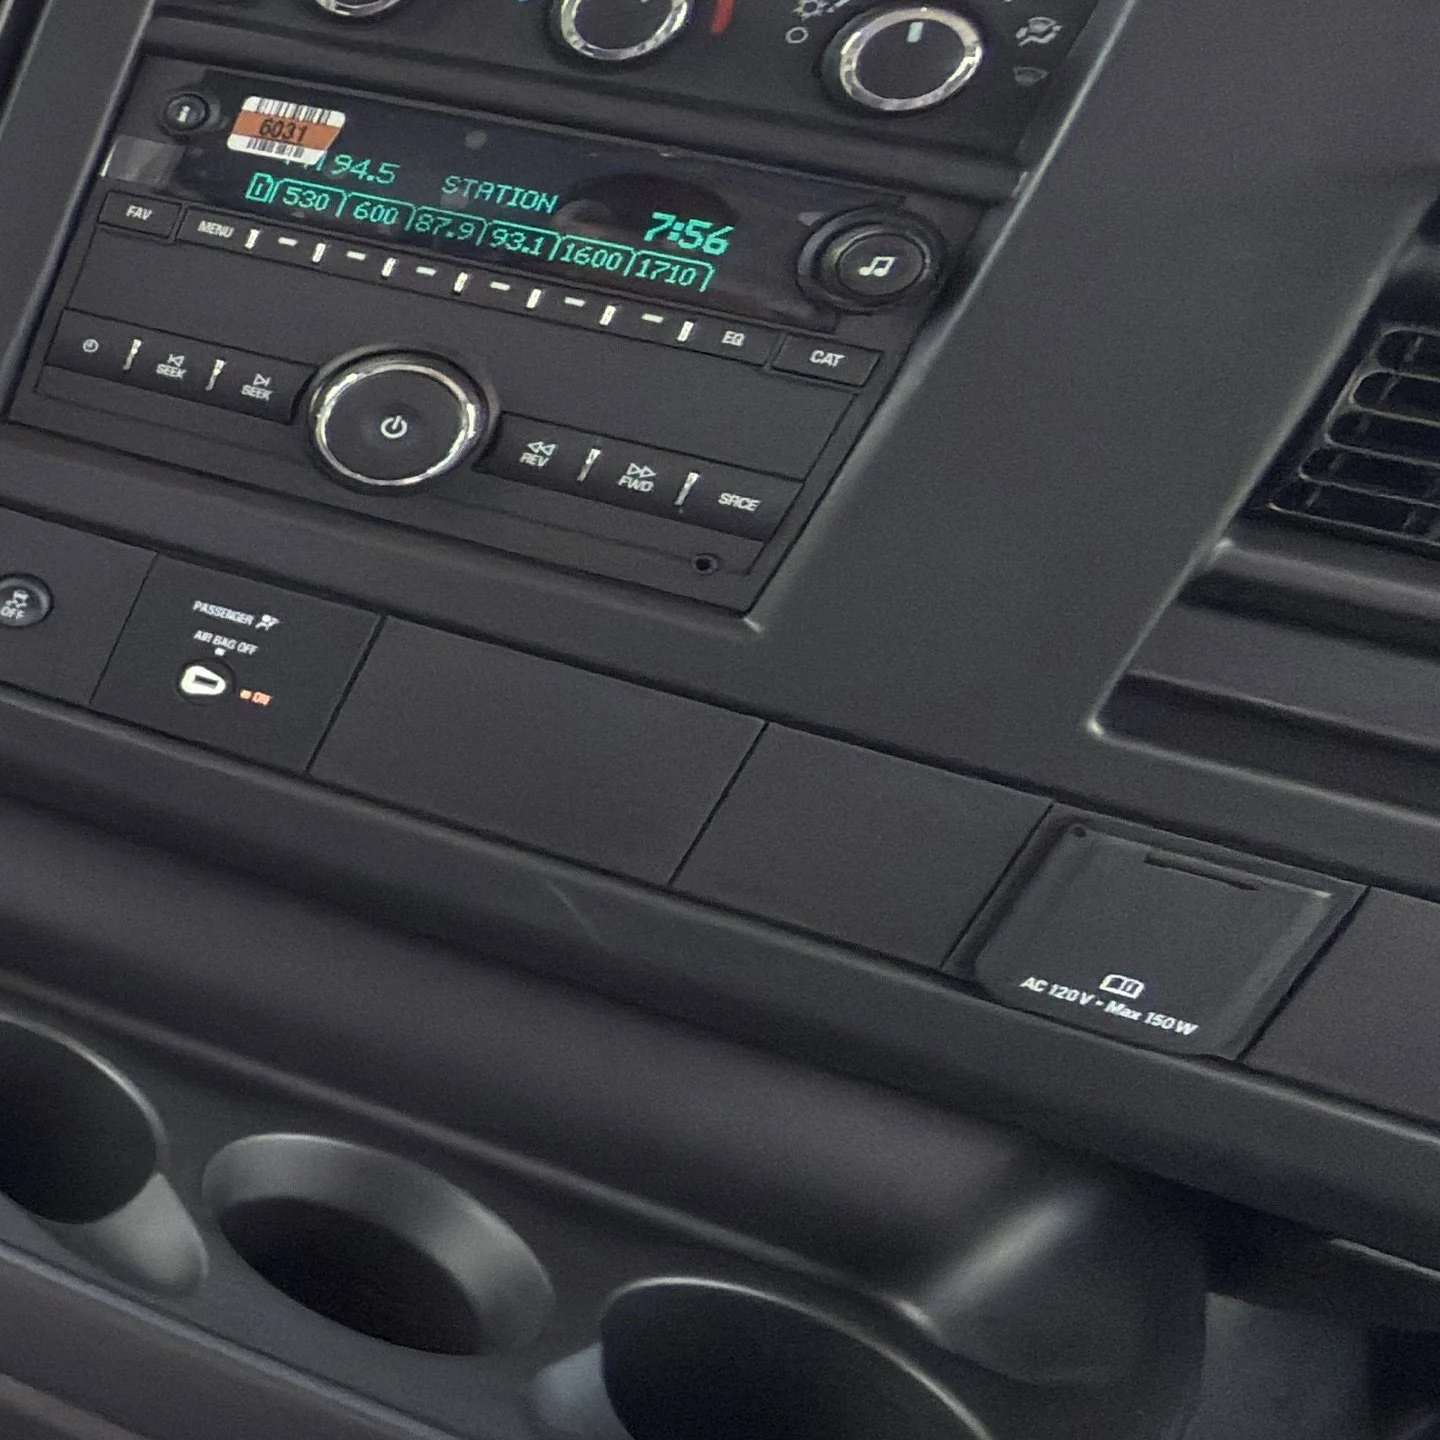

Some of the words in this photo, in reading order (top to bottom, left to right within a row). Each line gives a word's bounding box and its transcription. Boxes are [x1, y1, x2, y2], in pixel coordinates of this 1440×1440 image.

[259, 118, 308, 142] 6031
[330, 154, 400, 184] 94.5
[441, 175, 559, 214] STATION
[126, 205, 152, 220] FAV
[197, 220, 235, 238] MENU
[283, 186, 330, 211] 530
[353, 201, 399, 225] 600
[415, 213, 475, 240] 87.9
[490, 228, 542, 256] 93.1
[559, 243, 623, 271] 1600
[635, 258, 697, 286] 1710
[644, 212, 734, 255] 7:56
[722, 331, 745, 347] EQ
[809, 350, 846, 367] CAT
[156, 363, 188, 379] SEEK
[241, 384, 273, 401] SEEK
[519, 452, 550, 468] REV
[617, 475, 655, 492] FWD
[718, 492, 763, 512] SRCE
[0, 606, 25, 620] OFF
[192, 600, 255, 626] PASSENGER
[193, 630, 213, 643] AIR
[212, 635, 237, 650] BAG
[237, 642, 258, 655] OFF
[1019, 976, 1049, 992] AC
[1103, 1000, 1143, 1021] Max
